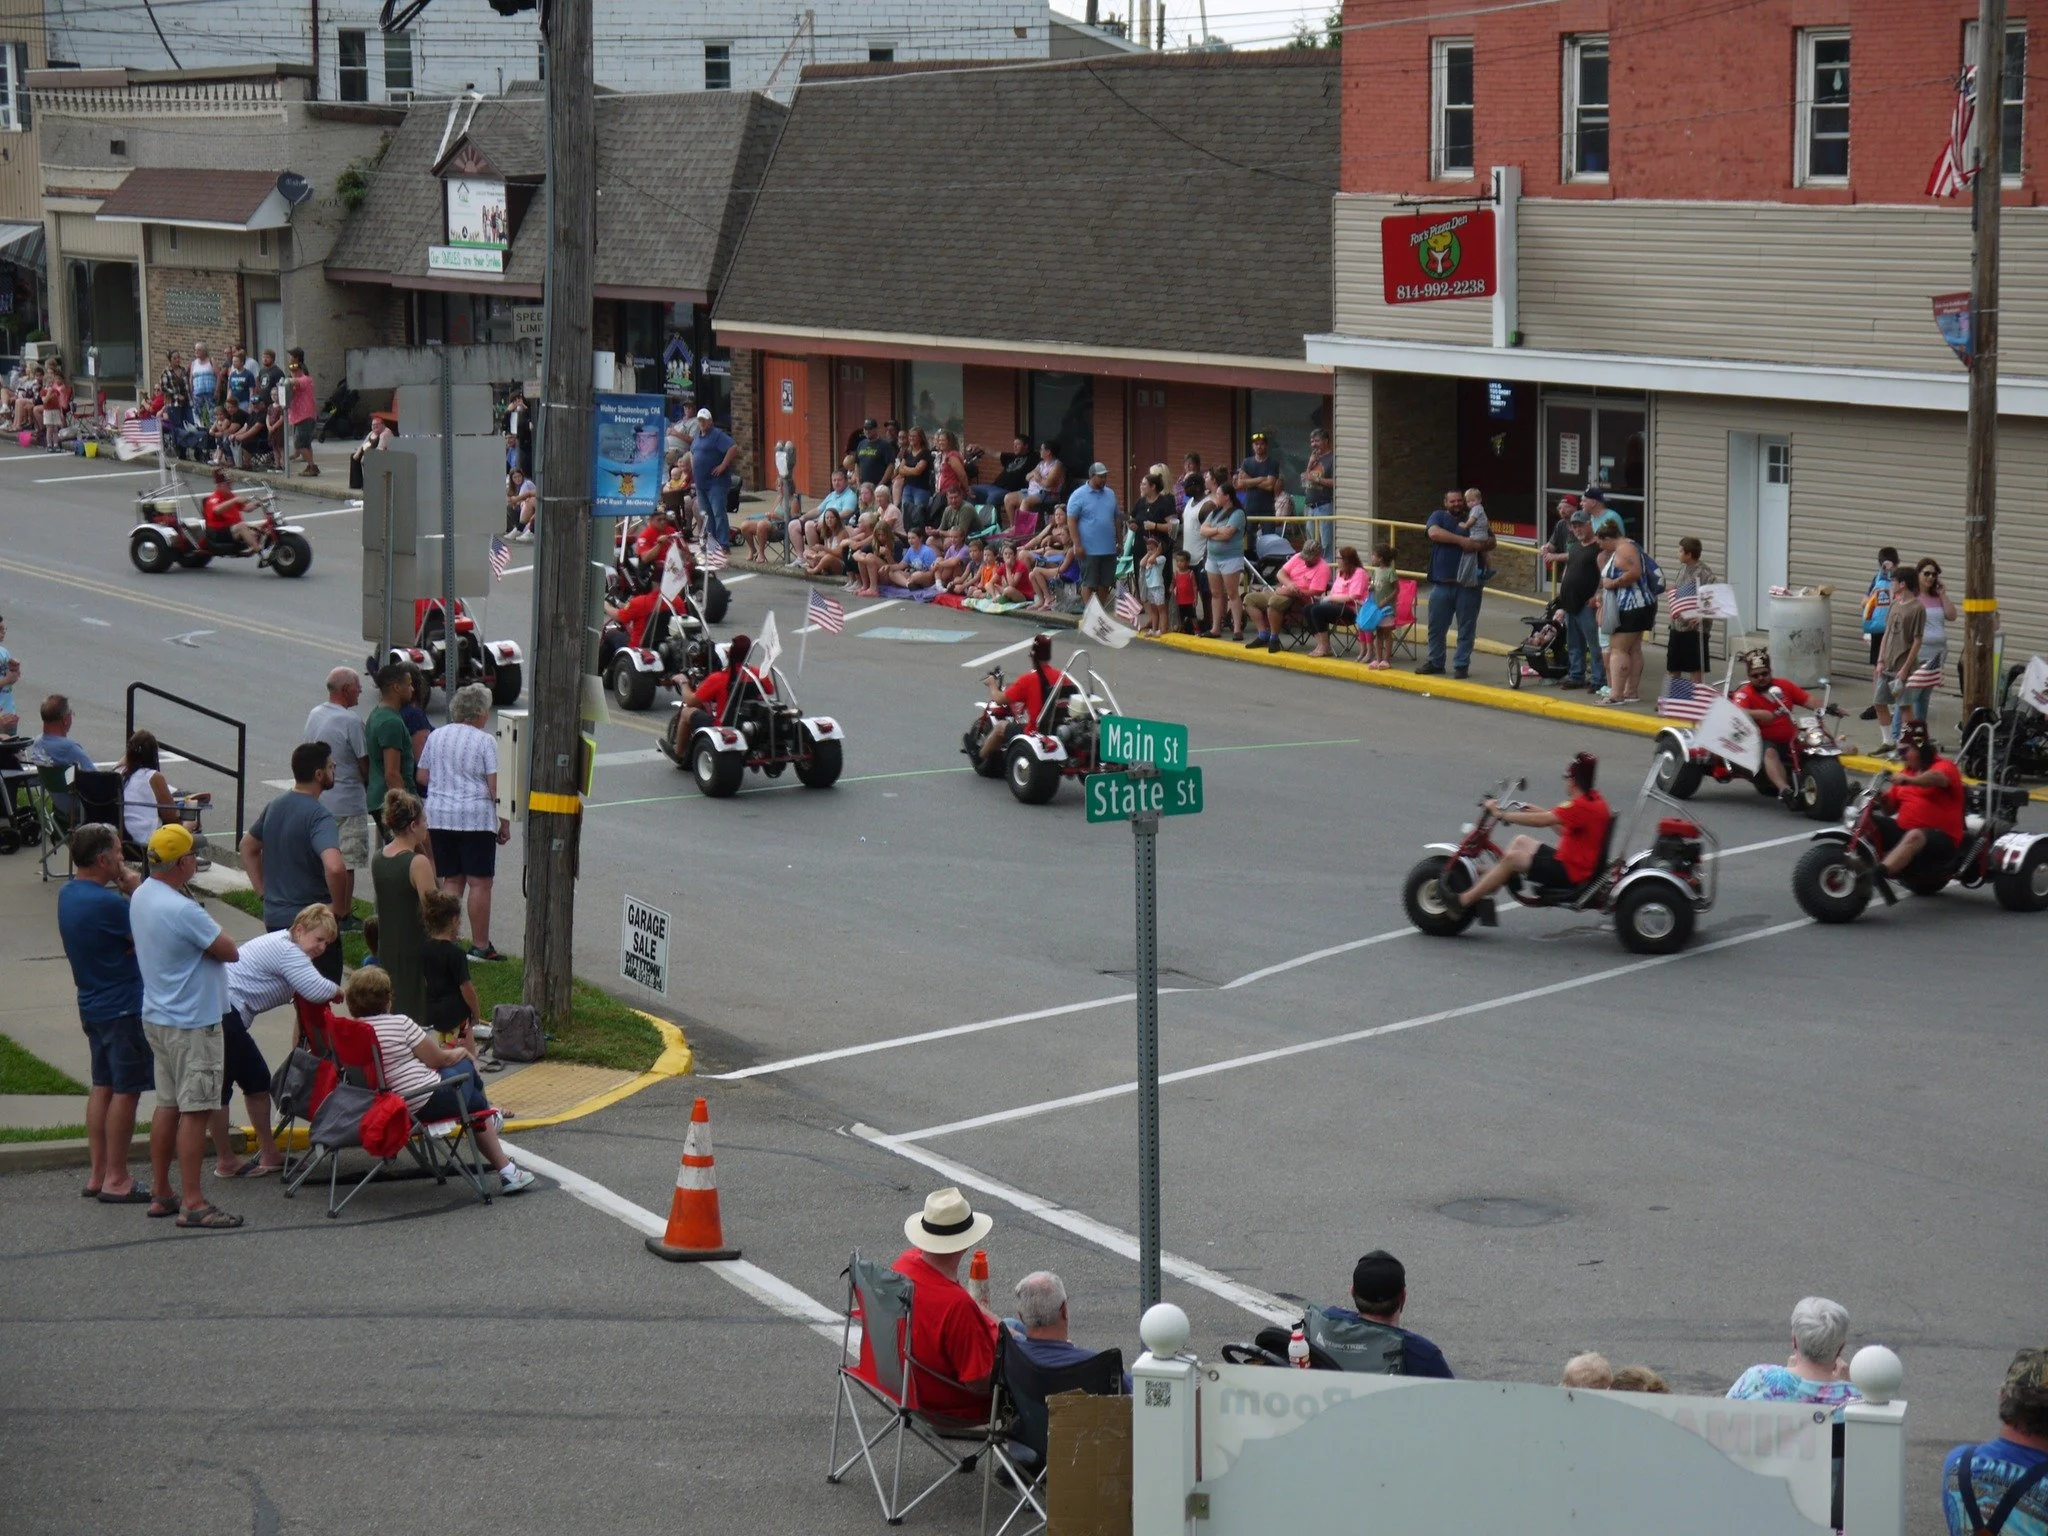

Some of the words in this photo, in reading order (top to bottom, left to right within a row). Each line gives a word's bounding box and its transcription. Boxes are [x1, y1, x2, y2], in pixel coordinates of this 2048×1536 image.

[1410, 229, 1430, 247] Fox's
[1429, 221, 1451, 238] Pizza
[1451, 215, 1468, 230] Den
[1396, 279, 1486, 299] 814-992-2238
[516, 312, 543, 322] SPEE
[520, 324, 544, 333] LIMI
[614, 414, 644, 424] Honors
[1108, 723, 1154, 762] Main
[1163, 737, 1179, 764] St
[1094, 779, 1164, 816] State
[1177, 779, 1196, 806] St
[628, 904, 666, 940] GARAGE
[633, 931, 657, 961] SALE
[625, 950, 661, 978] DITTYTOWN
